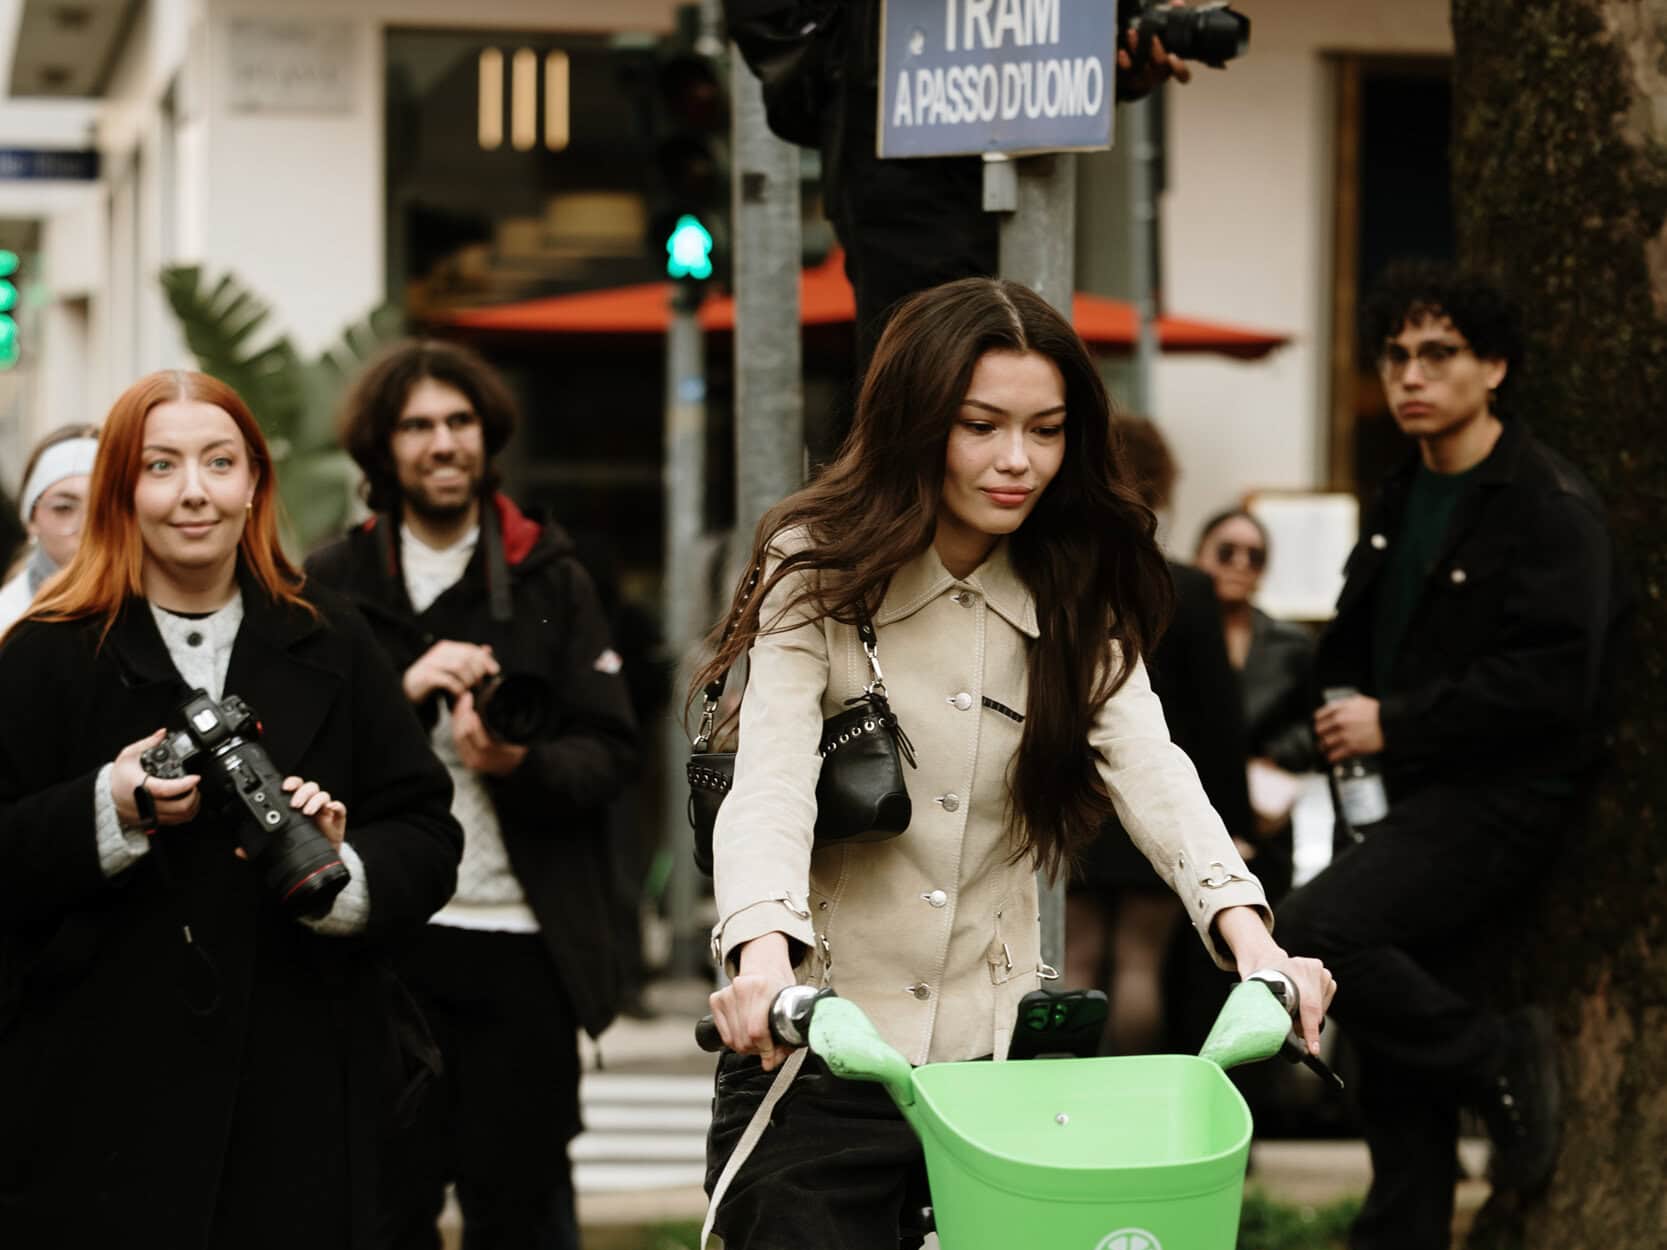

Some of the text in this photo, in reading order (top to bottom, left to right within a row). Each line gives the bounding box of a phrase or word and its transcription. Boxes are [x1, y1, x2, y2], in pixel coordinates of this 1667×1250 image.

[893, 57, 1103, 127] A PASSO D'UOMO
